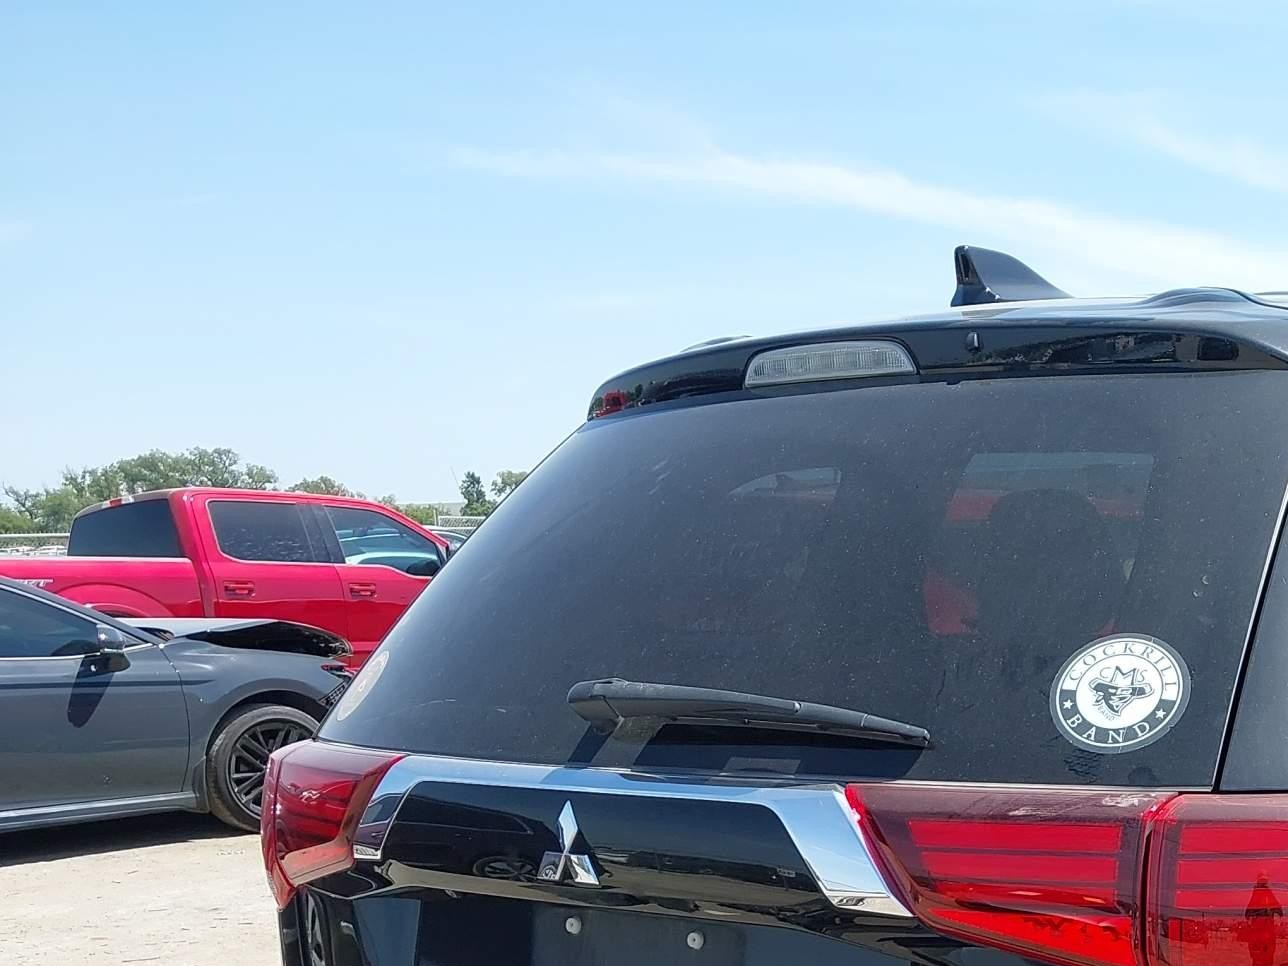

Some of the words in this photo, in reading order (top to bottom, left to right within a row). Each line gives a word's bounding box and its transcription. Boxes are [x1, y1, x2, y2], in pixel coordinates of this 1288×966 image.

[1069, 642, 1177, 691] COCKRILL
[1099, 665, 1148, 686] CMS
[1066, 713, 1150, 744] BAND
